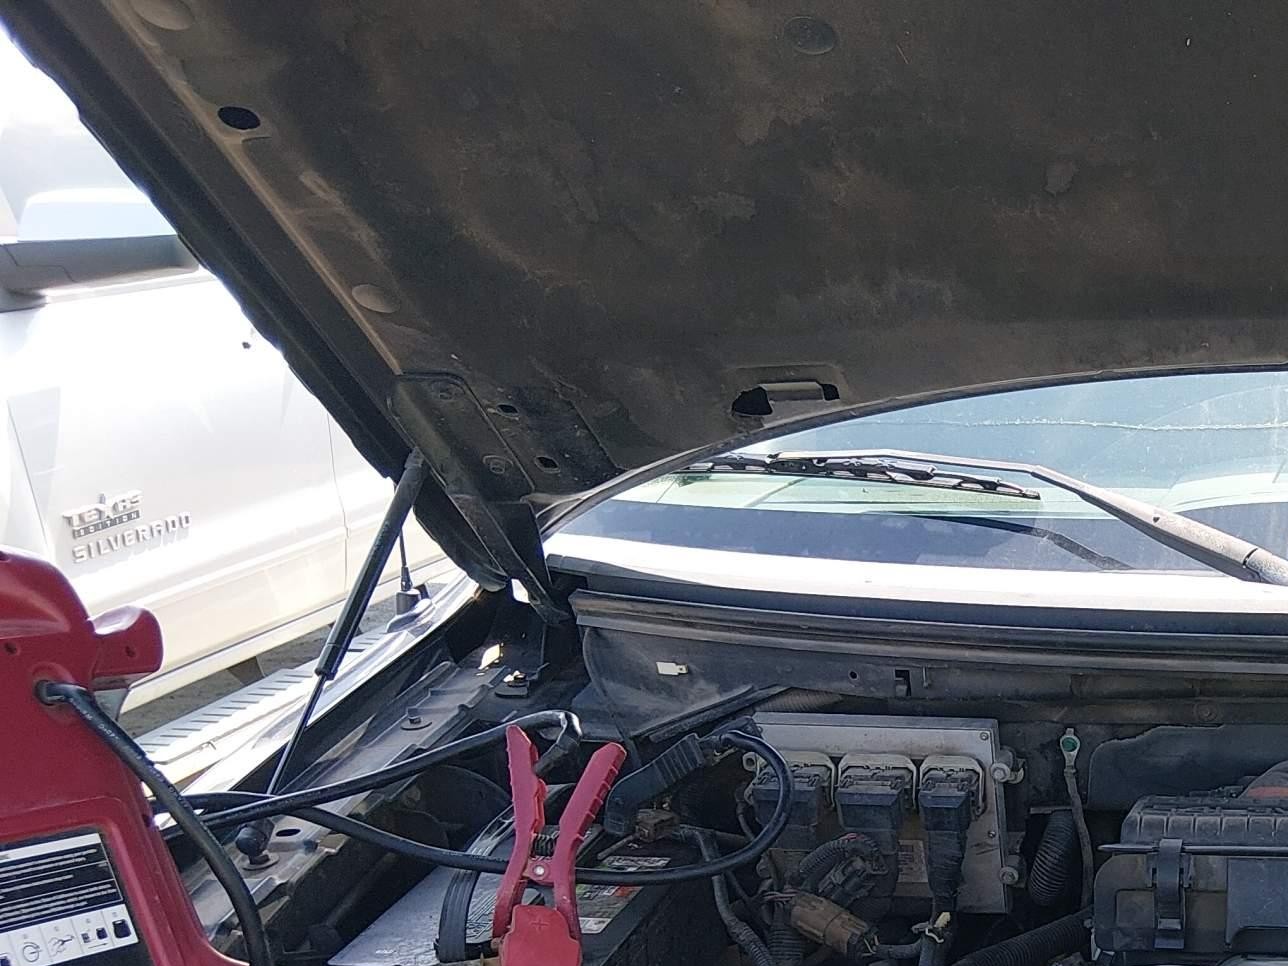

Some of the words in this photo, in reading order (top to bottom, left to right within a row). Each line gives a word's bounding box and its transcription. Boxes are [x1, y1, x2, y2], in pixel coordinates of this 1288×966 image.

[61, 489, 144, 527] TEXAS
[73, 510, 141, 539] EDITION
[72, 512, 192, 564] SILVERADO
